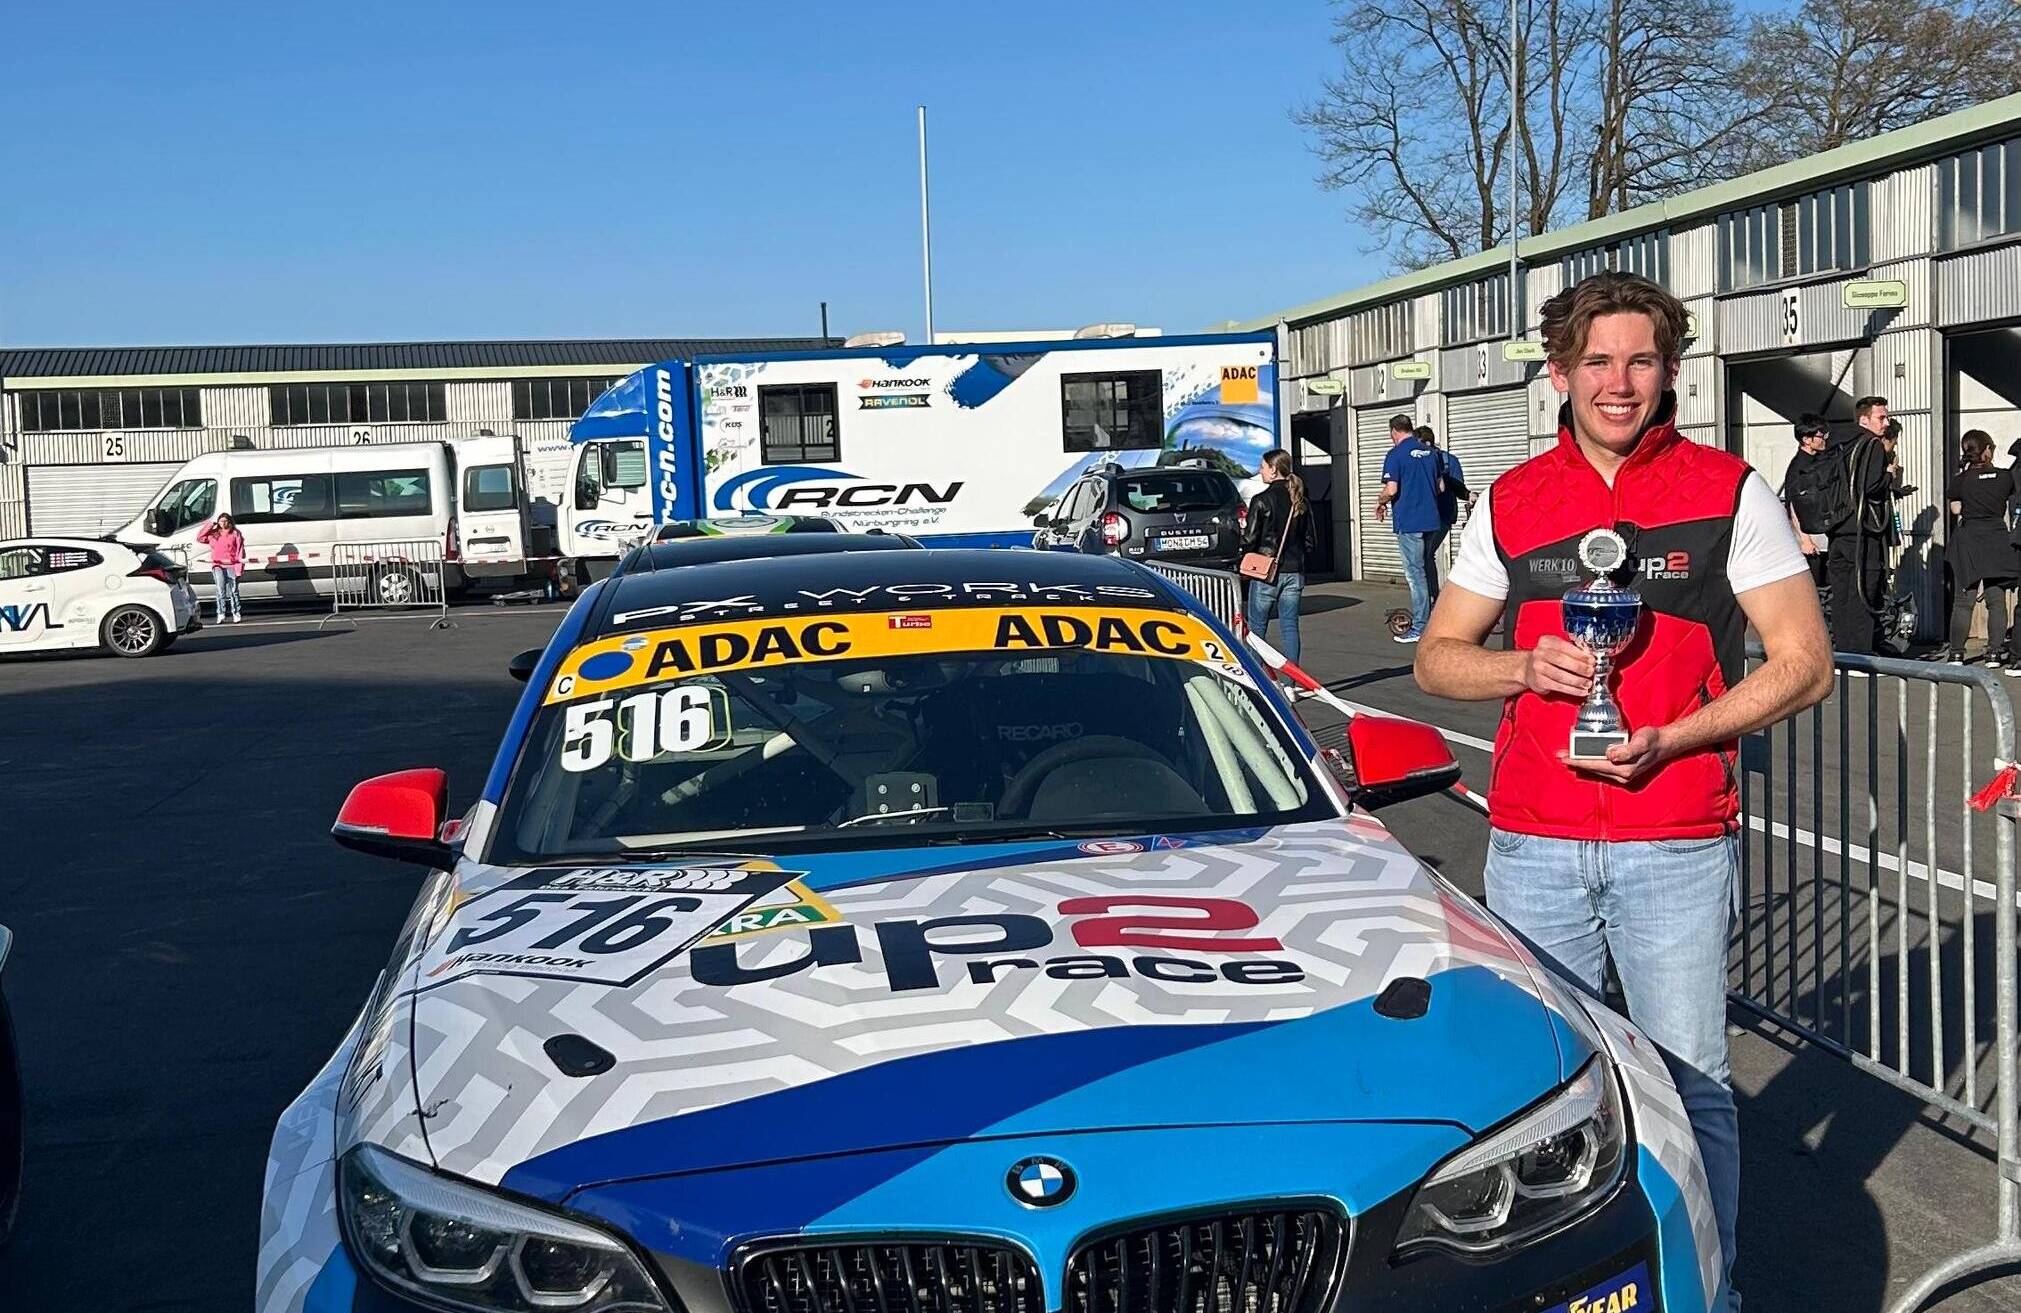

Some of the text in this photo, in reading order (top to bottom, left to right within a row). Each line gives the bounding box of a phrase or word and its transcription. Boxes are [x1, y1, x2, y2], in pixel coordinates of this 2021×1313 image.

[1783, 296, 1798, 336] 35
[1222, 366, 1257, 380] ADAC
[711, 386, 733, 398] H&R
[864, 397, 926, 407] RAVENOL
[105, 437, 124, 456] 25
[775, 481, 965, 509] RCN
[594, 523, 649, 532] RCN
[1529, 558, 1578, 573] WERK 10
[1654, 571, 1689, 580] race
[797, 582, 1156, 601] WORKS
[679, 597, 867, 622] STREET
[993, 614, 1192, 656] ADAC
[645, 621, 852, 679] ADAC
[1205, 642, 1224, 661] 2
[557, 676, 574, 695] C
[561, 684, 713, 772] 516
[997, 722, 1084, 741] RECARO
[550, 868, 684, 889] H&R
[446, 893, 704, 955] 516
[689, 895, 1285, 993] up2
[967, 955, 1307, 986] race
[1012, 1156, 1068, 1175] BMW
